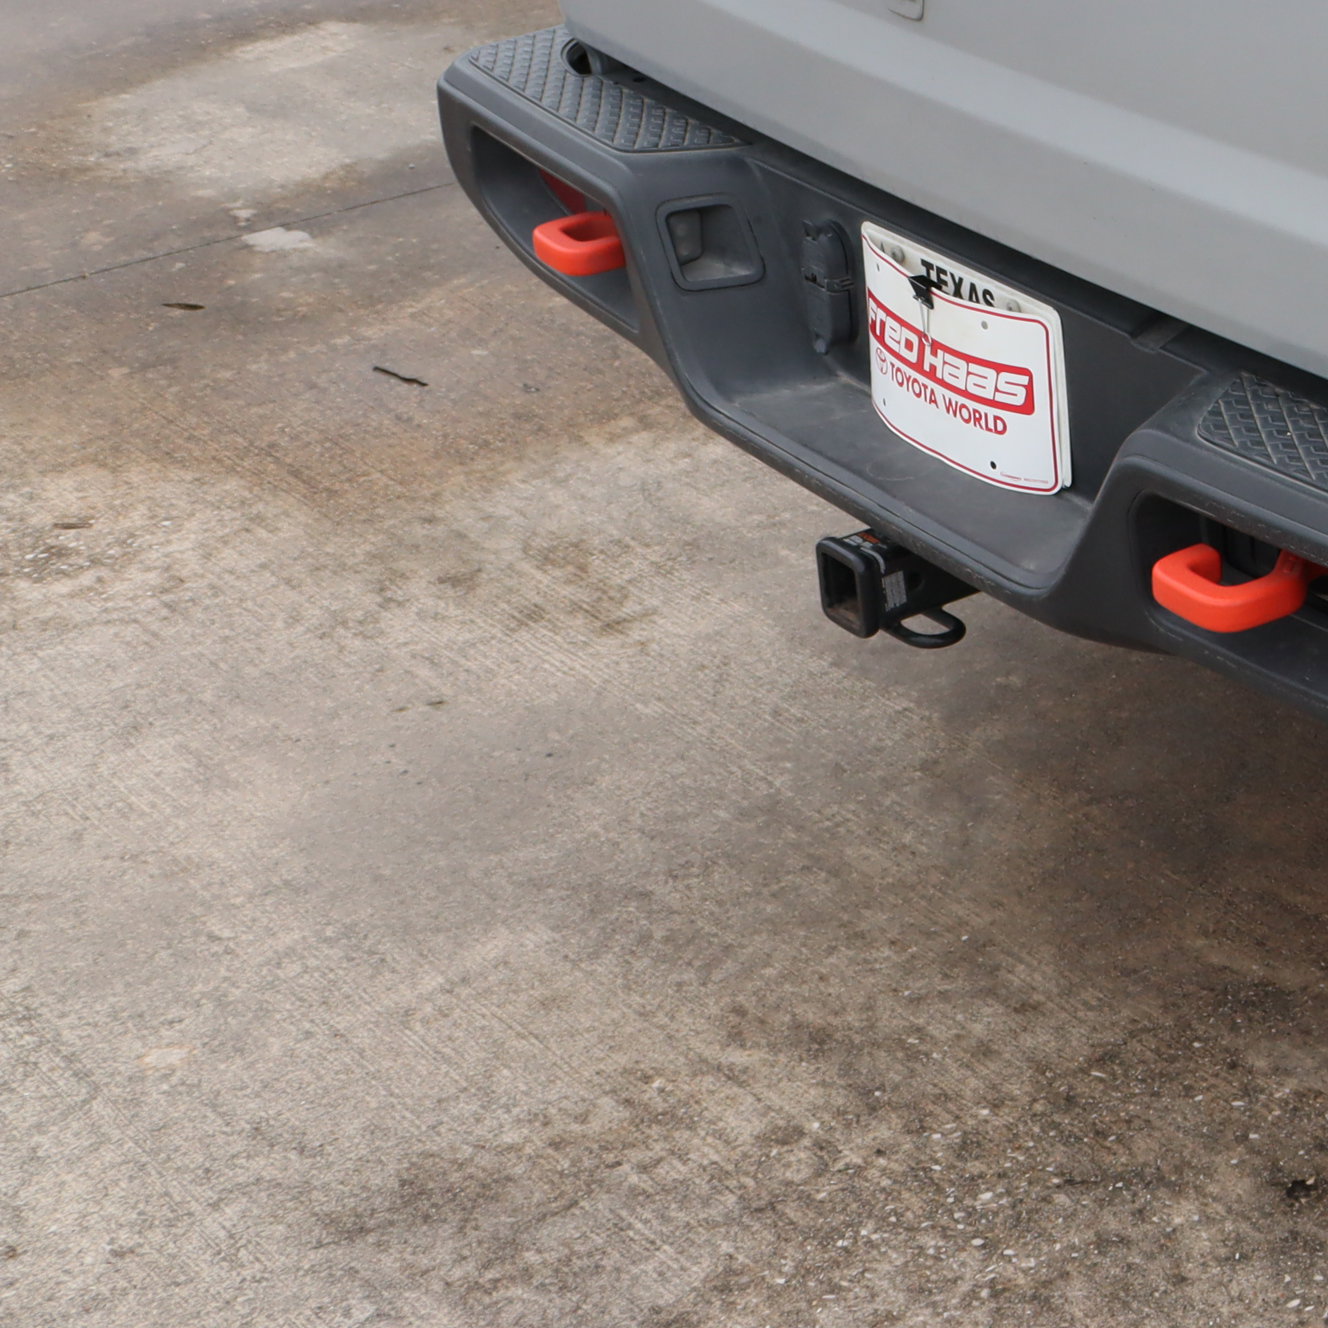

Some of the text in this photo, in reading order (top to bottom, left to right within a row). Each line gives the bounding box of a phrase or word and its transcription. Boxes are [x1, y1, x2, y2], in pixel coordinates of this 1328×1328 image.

[921, 258, 996, 308] TEXAS
[889, 361, 1008, 436] TOYOTA WORLD
